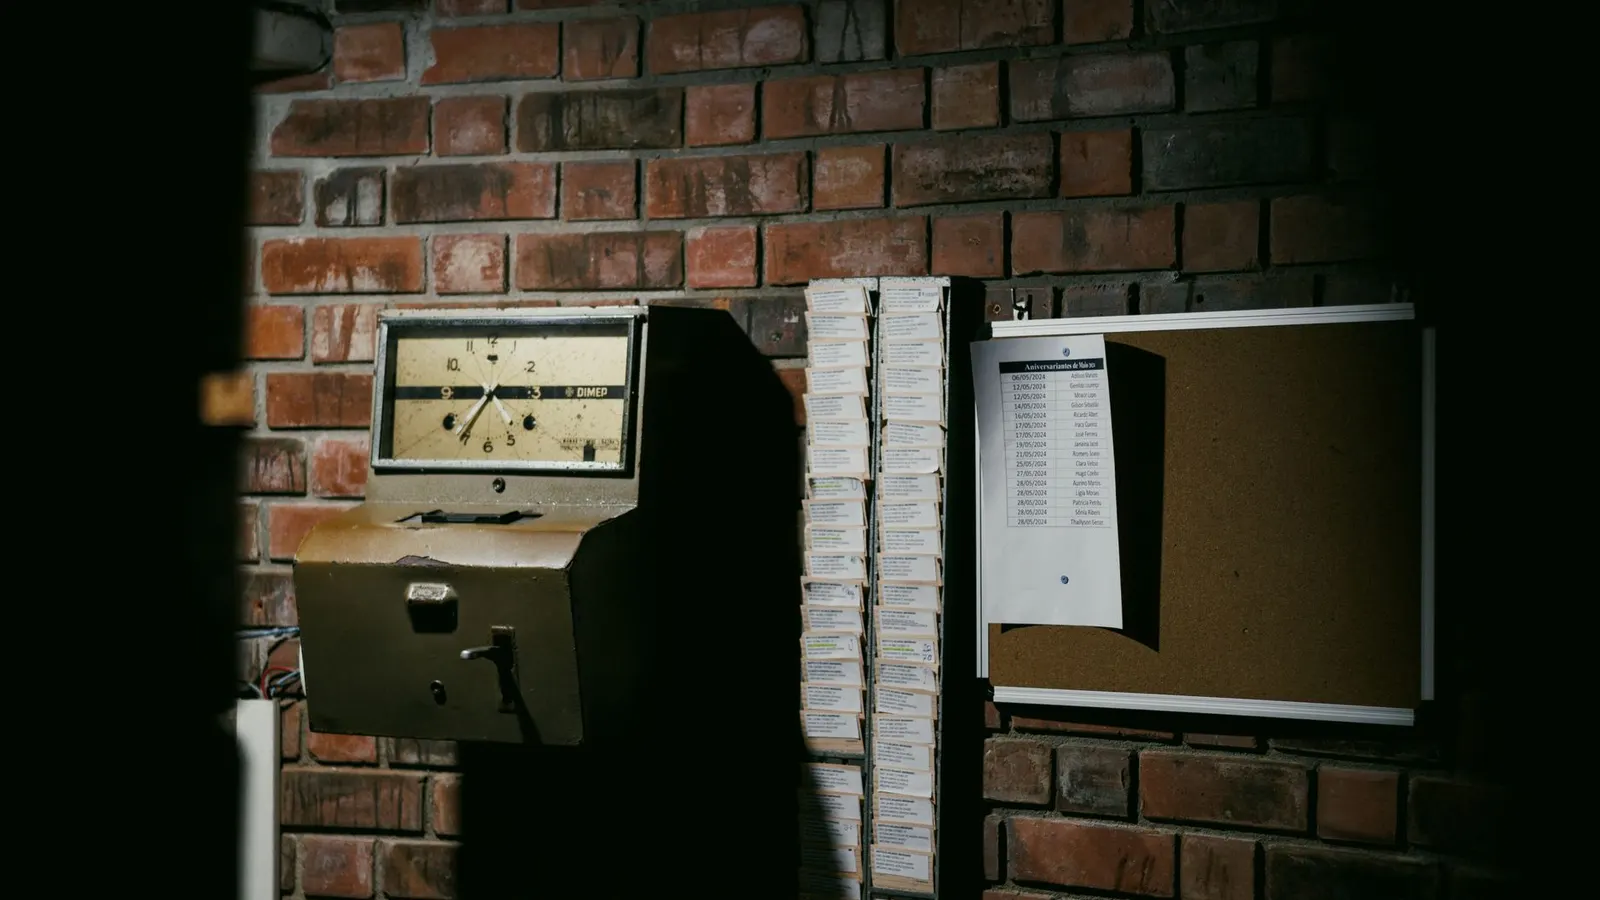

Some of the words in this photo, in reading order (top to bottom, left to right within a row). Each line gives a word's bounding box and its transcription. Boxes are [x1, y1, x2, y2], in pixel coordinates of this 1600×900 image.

[466, 340, 473, 352] 11
[487, 336, 498, 344] 12
[447, 358, 458, 371] 10
[527, 361, 536, 373] 2
[441, 386, 451, 400] 9
[577, 387, 608, 399] DIMEP
[1013, 383, 1046, 391] 12/05/2024
[532, 387, 541, 400] 3
[1014, 402, 1046, 410] 14/05/2024
[506, 434, 515, 446] 5
[483, 441, 494, 453] 6
[1016, 450, 1047, 458] 21/05/2024
[1017, 508, 1047, 516] 28/05/2024
